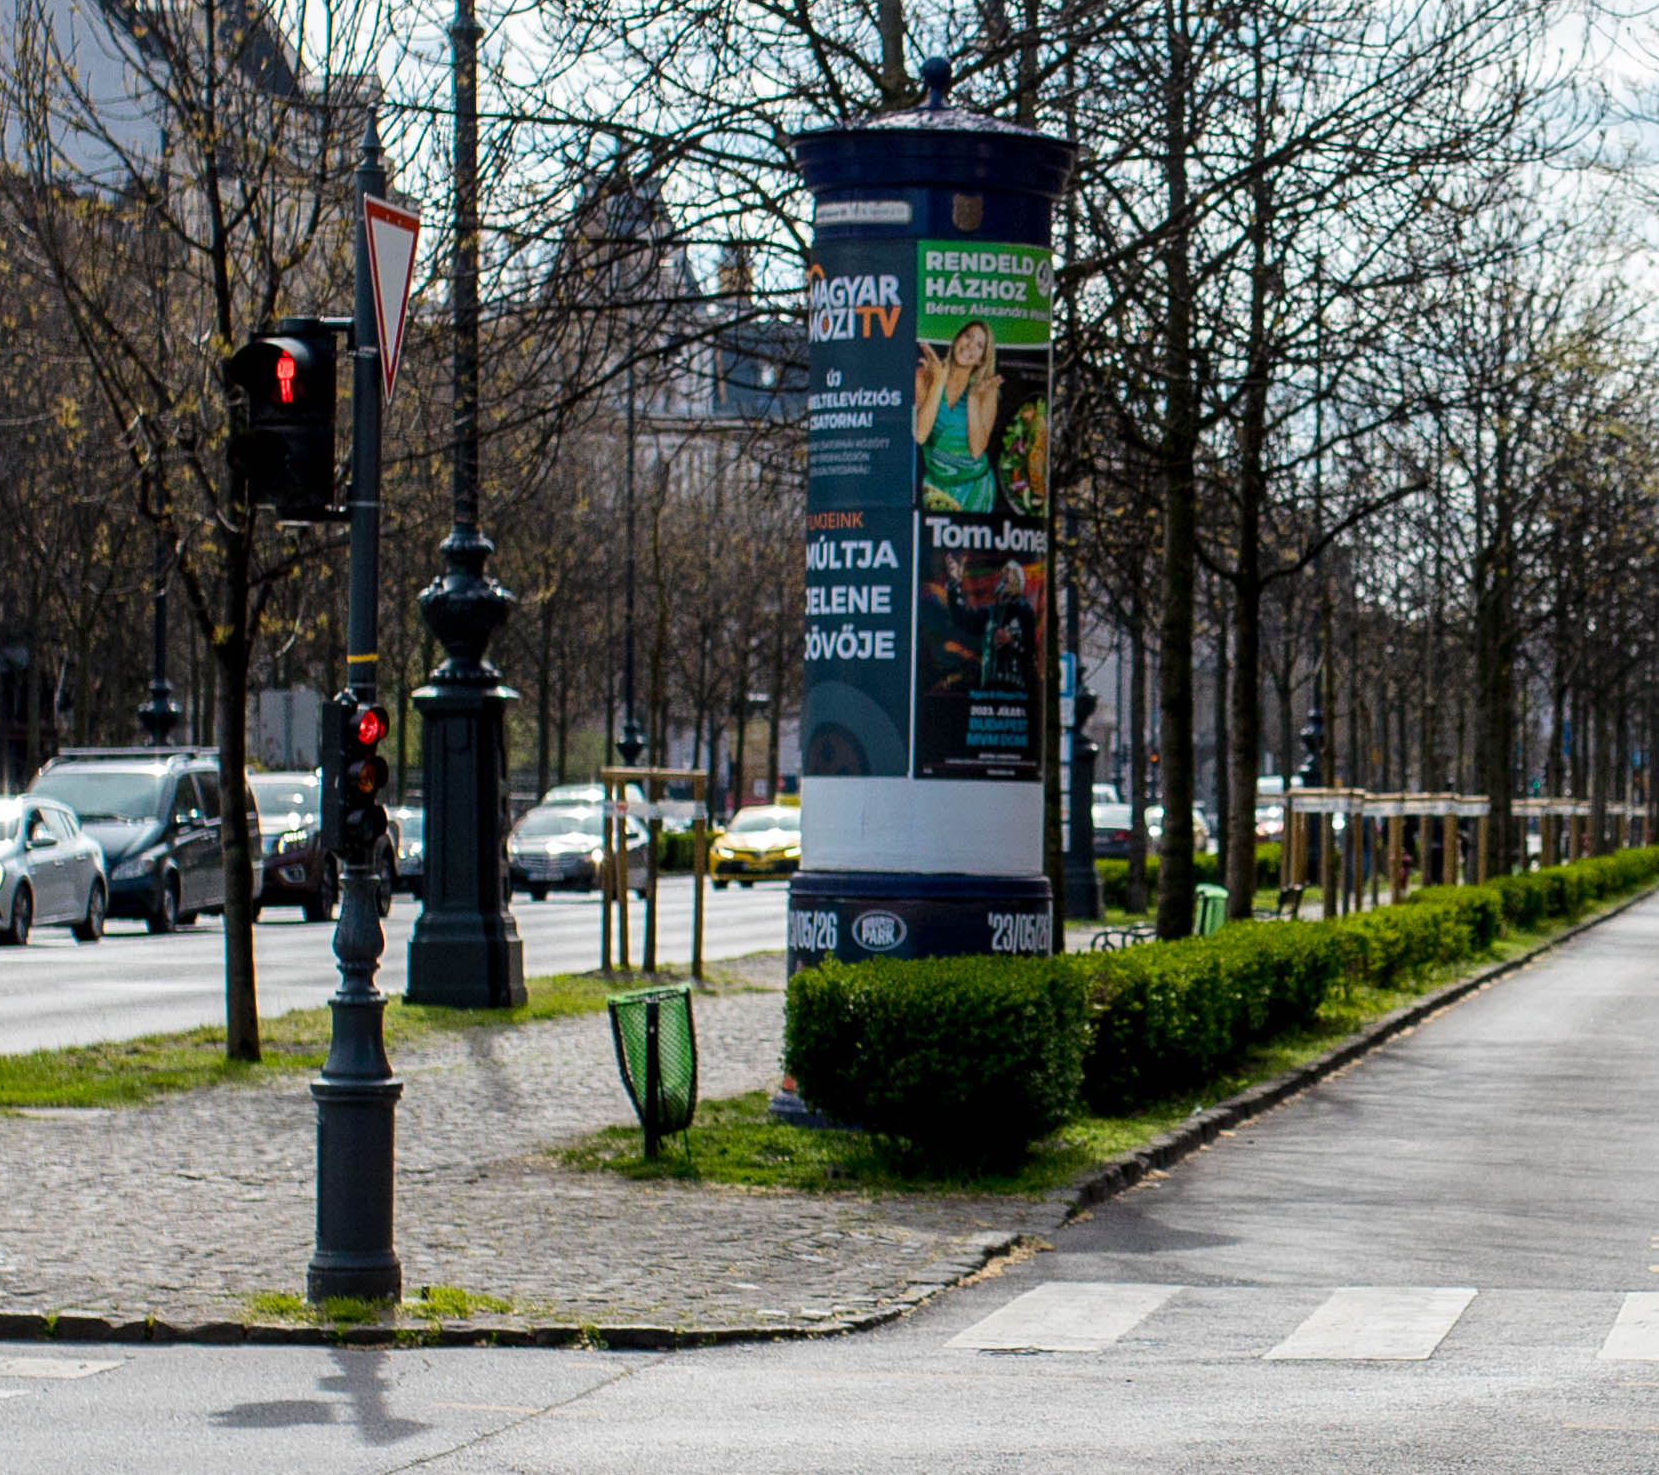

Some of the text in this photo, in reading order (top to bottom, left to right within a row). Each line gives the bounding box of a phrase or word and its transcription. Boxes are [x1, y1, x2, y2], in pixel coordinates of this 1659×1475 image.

[925, 250, 1034, 276] RENDELD
[810, 274, 902, 311] MAGYAR
[925, 272, 1027, 301] HÁZHOZ
[925, 301, 966, 316] Béres
[809, 306, 902, 344] MOZI TV
[826, 368, 842, 388] ÚJ
[925, 517, 991, 549] Tom
[806, 535, 899, 572] MÚLTJA
